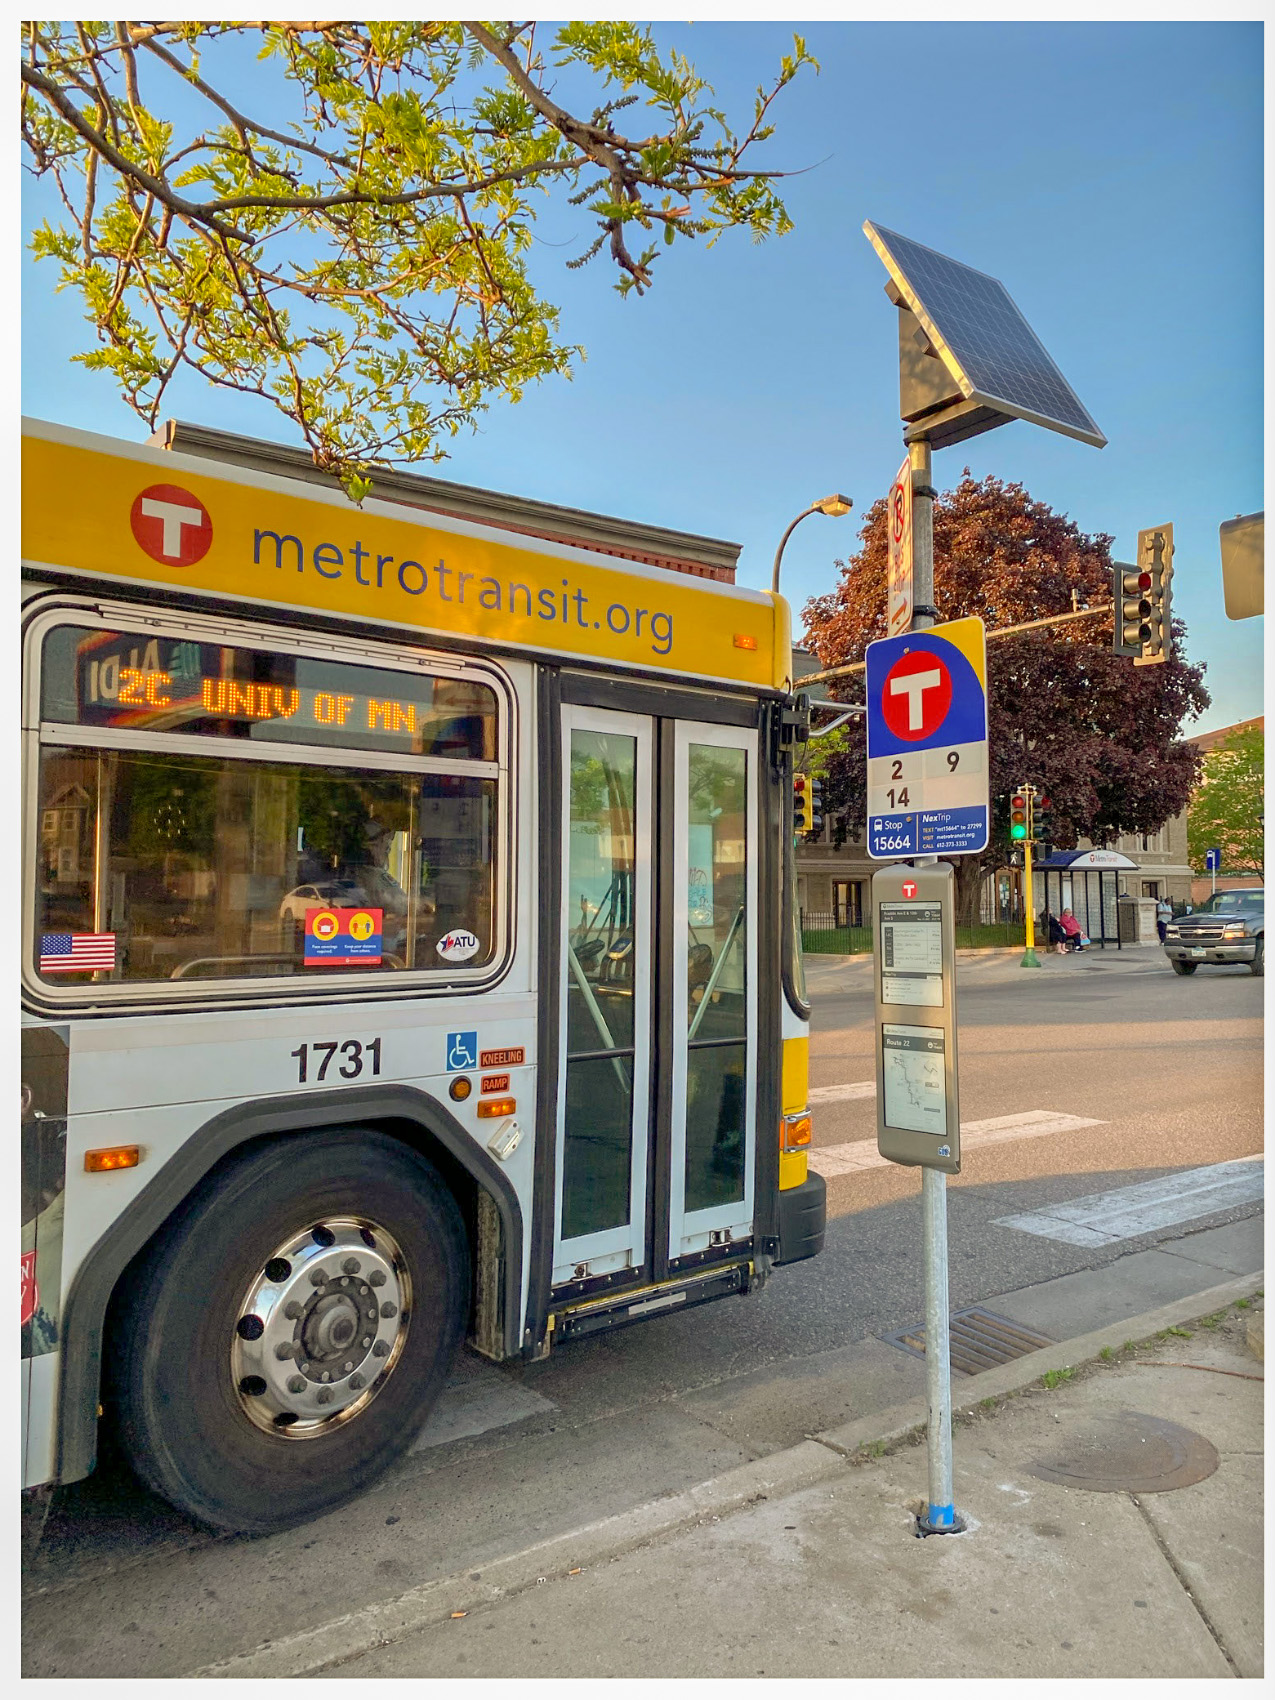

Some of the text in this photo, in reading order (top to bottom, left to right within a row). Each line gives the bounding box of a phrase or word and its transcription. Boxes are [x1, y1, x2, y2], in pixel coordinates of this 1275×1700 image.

[253, 527, 674, 656] metrotransit.org
[117, 669, 417, 733] 2C UNIV OF MN
[890, 668, 941, 731] T
[891, 751, 960, 780] 2 9
[886, 787, 910, 809] 14
[884, 820, 903, 832] Stop
[922, 813, 951, 823] NexTrip
[873, 835, 911, 851] 15664
[903, 884, 915, 897] T
[454, 936, 476, 947] ATU
[291, 1037, 382, 1083] 1731
[482, 1050, 522, 1066] KNEELING
[483, 1077, 507, 1091] RAMP
